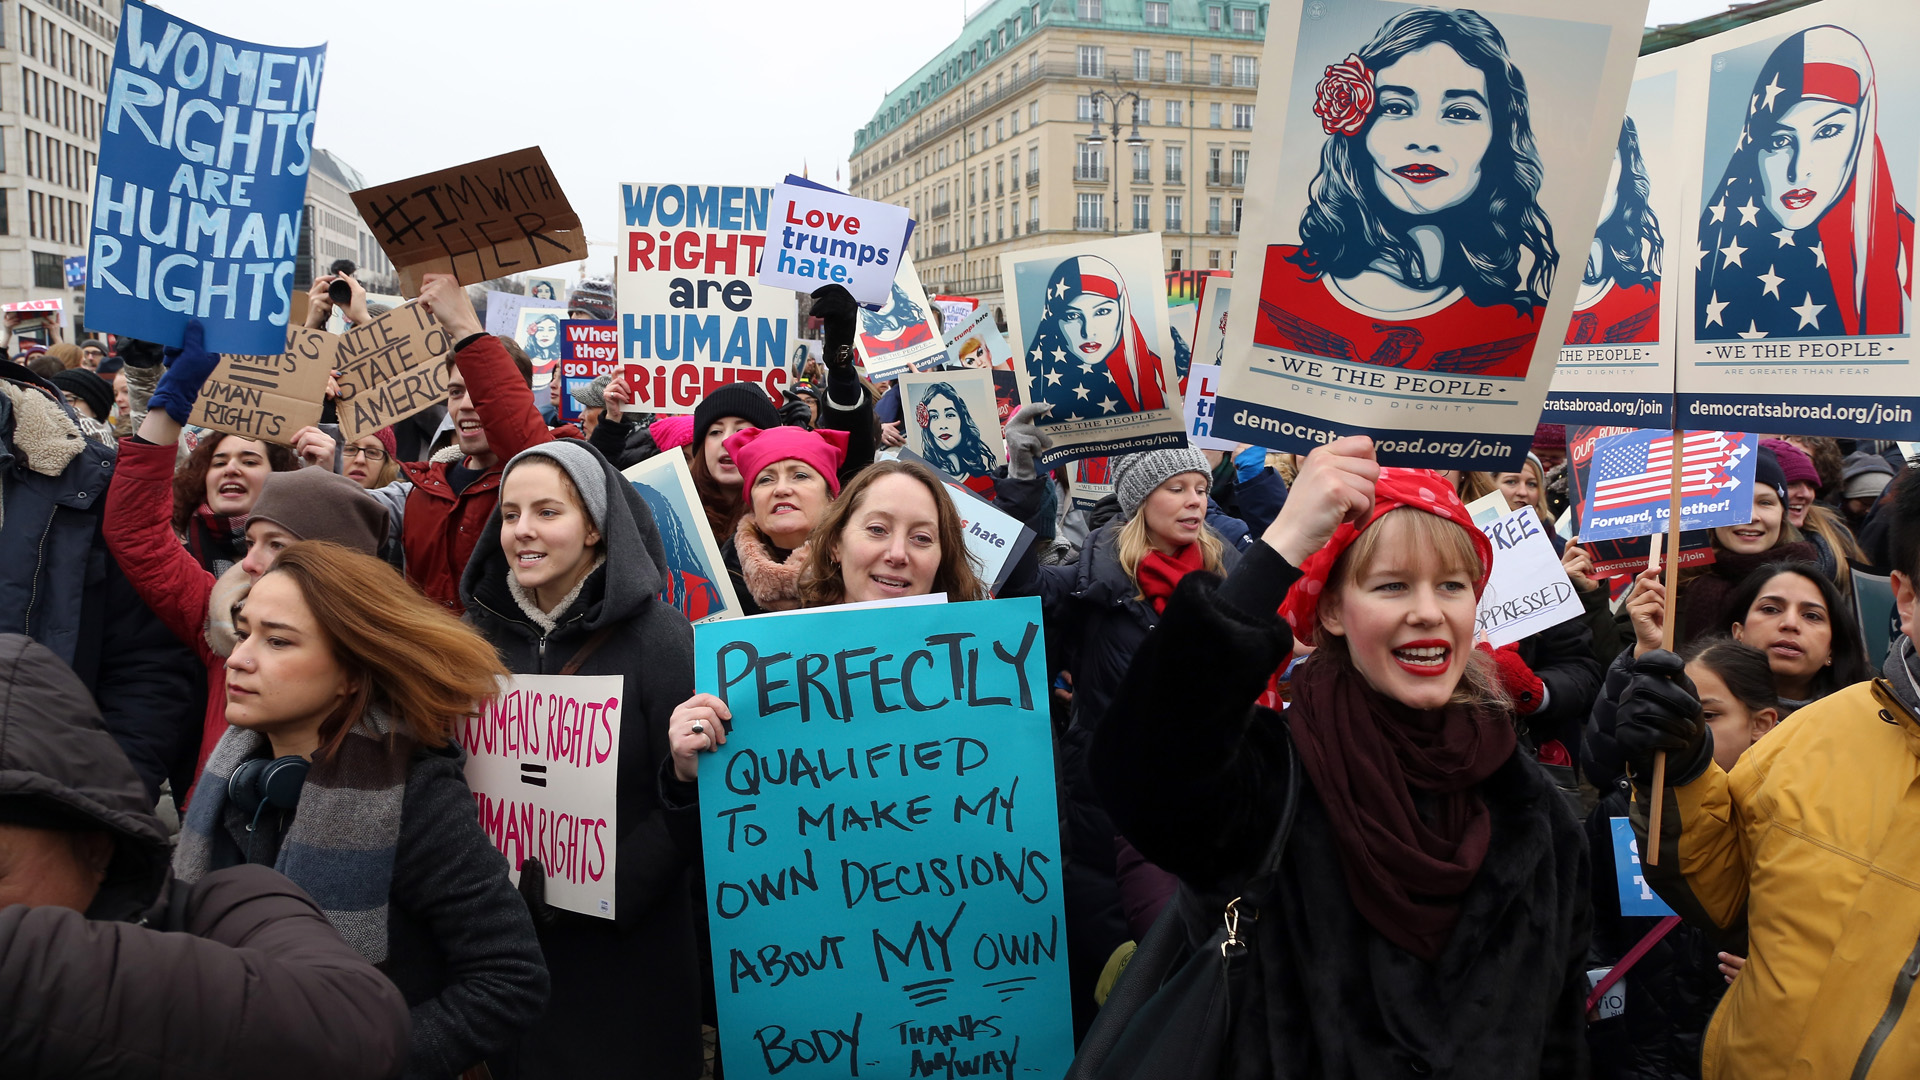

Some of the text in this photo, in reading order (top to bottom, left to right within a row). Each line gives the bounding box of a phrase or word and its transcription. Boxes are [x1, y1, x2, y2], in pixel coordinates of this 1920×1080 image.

[107, 68, 316, 176] RIGHTS
[169, 164, 255, 207] ARE
[95, 175, 302, 258] HUMAN
[786, 201, 861, 234] Love
[436, 212, 572, 287] HER
[782, 226, 890, 266] trumps
[92, 235, 295, 326] RIGHTS
[777, 250, 854, 284] hate.
[669, 278, 752, 312] are
[623, 314, 788, 367] HUMAN
[954, 323, 975, 341] trumps
[975, 312, 989, 325] hate
[575, 344, 617, 361] they
[1587, 348, 1642, 361] PEOPLE
[1715, 342, 1882, 359] WE THE PEOPLE
[564, 363, 588, 377] go
[1281, 356, 1493, 397] WE THE PEOPLE
[201, 380, 263, 408] UMAN
[354, 360, 449, 434] AMERIC
[1291, 384, 1475, 413] DEFEND DIGNITY
[1543, 398, 1663, 416] cratsabroad.org/join
[1690, 400, 1912, 423] democratsabroad.org/join
[203, 400, 286, 436] RIGHTS
[1050, 413, 1155, 432] WE THE PEOPLE
[1233, 409, 1512, 458] democratroad.org/join
[1041, 435, 1179, 465] democratsabroad.org/join
[1590, 500, 1730, 529] Forward, toether!
[969, 522, 1006, 548] hate
[716, 621, 1040, 736] PERFECTLY
[546, 692, 619, 768] RIGHTS
[725, 737, 989, 796] QUALIFIED
[798, 795, 932, 841] MAKE
[953, 776, 1019, 832] MY
[539, 808, 607, 884] RIGHTS
[716, 848, 1051, 919] OWN DECISIONS
[730, 901, 1058, 993] ABOUT MY OWN
[890, 1014, 1002, 1046] THANKS
